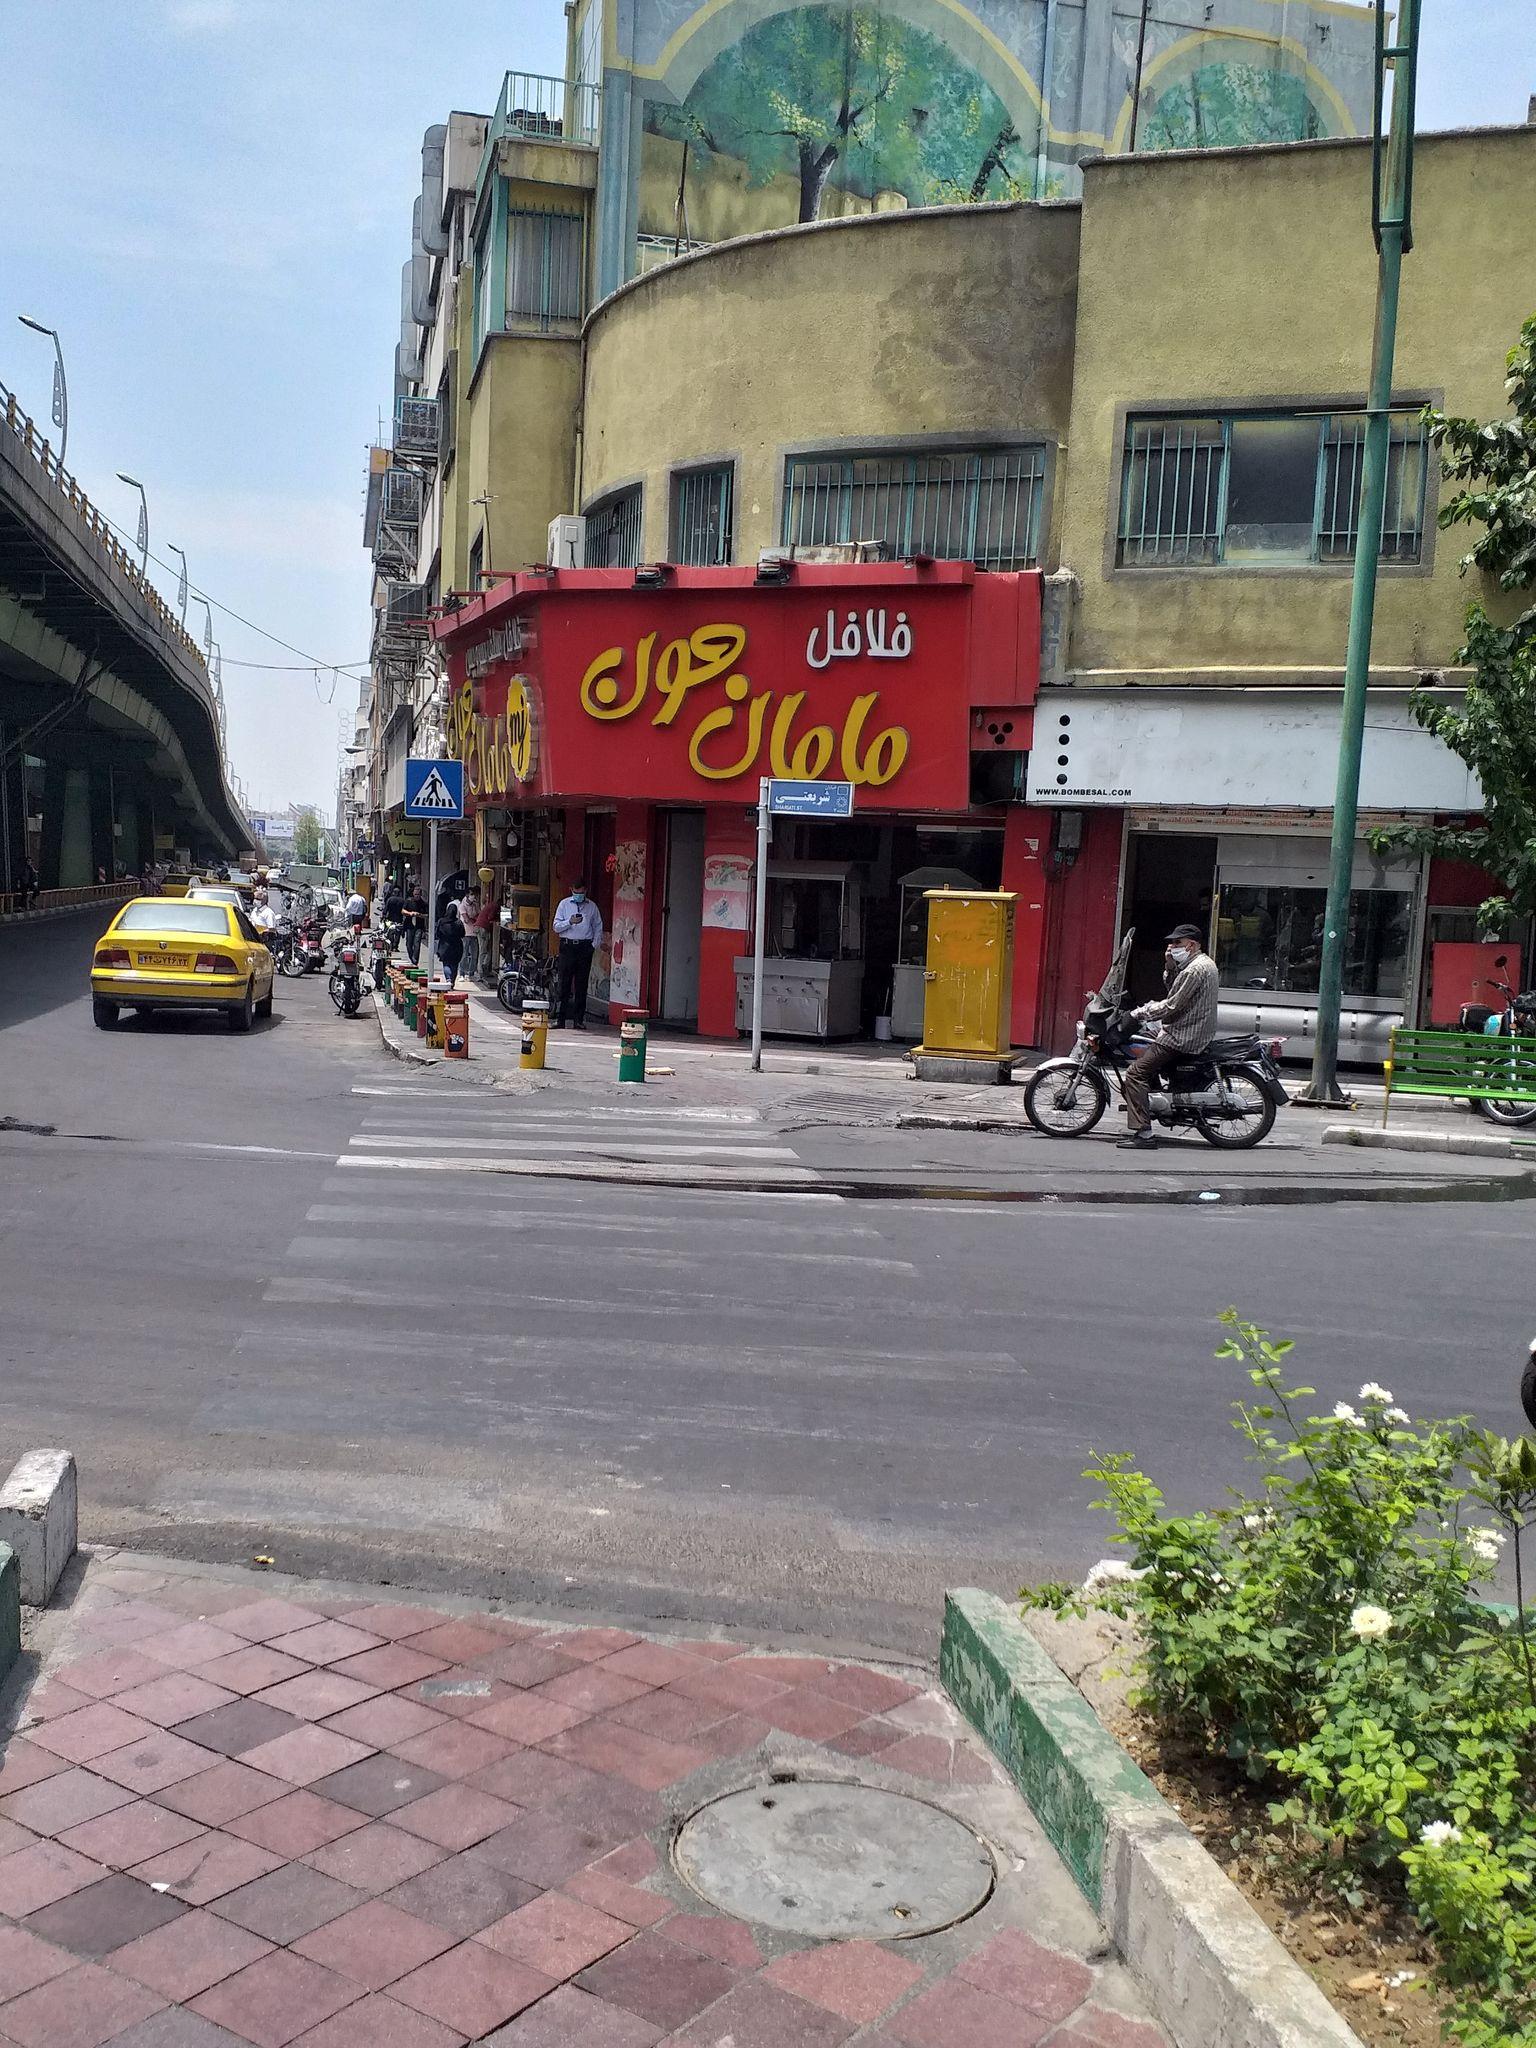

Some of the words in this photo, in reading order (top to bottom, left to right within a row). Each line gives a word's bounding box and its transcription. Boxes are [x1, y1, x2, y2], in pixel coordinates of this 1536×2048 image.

[580, 622, 747, 727] جون
[806, 608, 912, 669] فلافل
[689, 674, 909, 786] مامان
[775, 790, 830, 805] شریعتی
